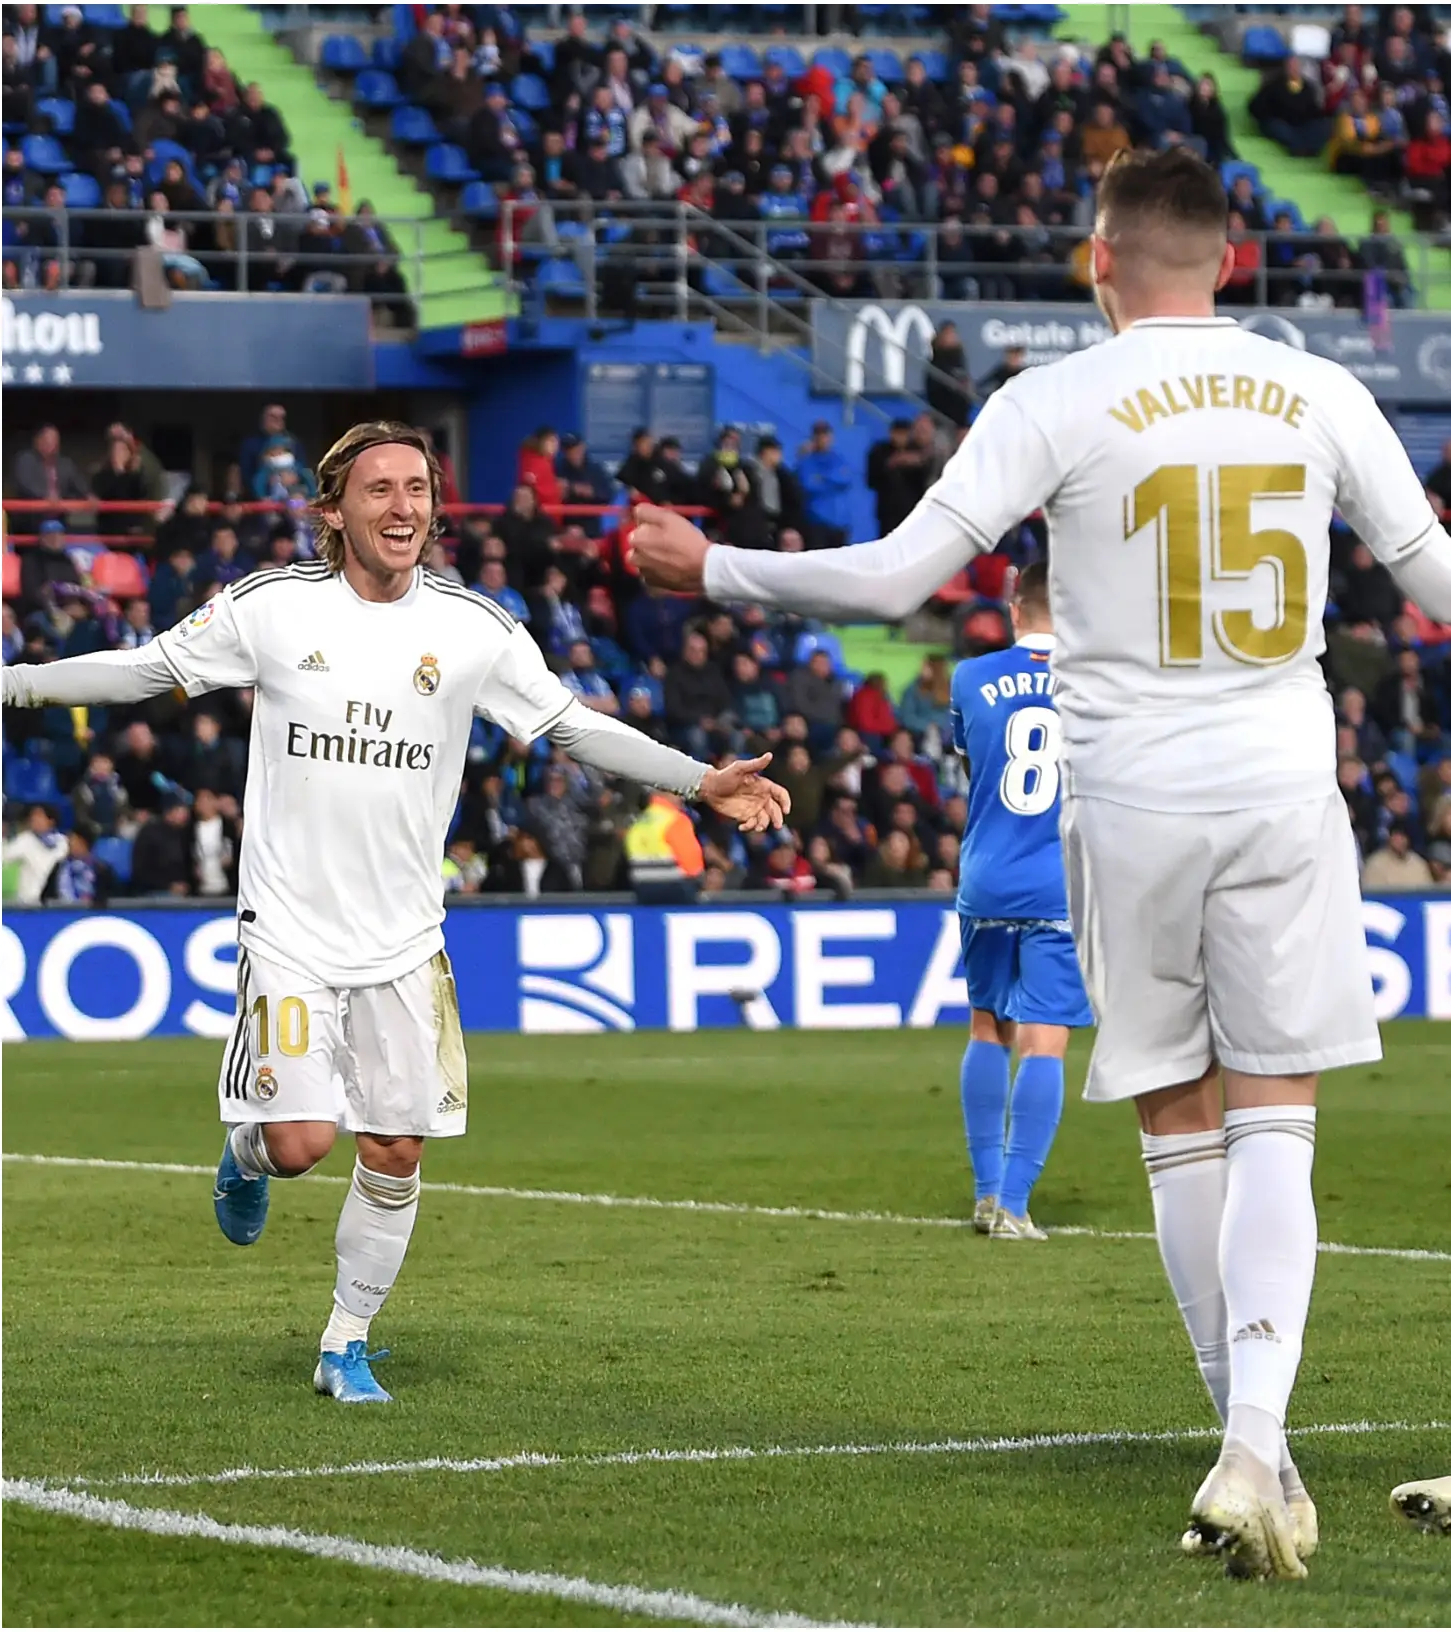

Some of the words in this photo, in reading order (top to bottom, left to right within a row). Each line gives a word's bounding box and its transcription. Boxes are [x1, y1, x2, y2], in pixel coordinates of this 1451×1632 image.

[1107, 374, 1309, 434] VALVERDE
[1123, 463, 1309, 668] 15
[297, 662, 330, 672] adidas
[346, 700, 393, 733] Fly
[287, 721, 434, 771] Emirates
[1000, 706, 1062, 816] 8
[250, 994, 310, 1058] 10
[437, 1101, 466, 1114] adidas
